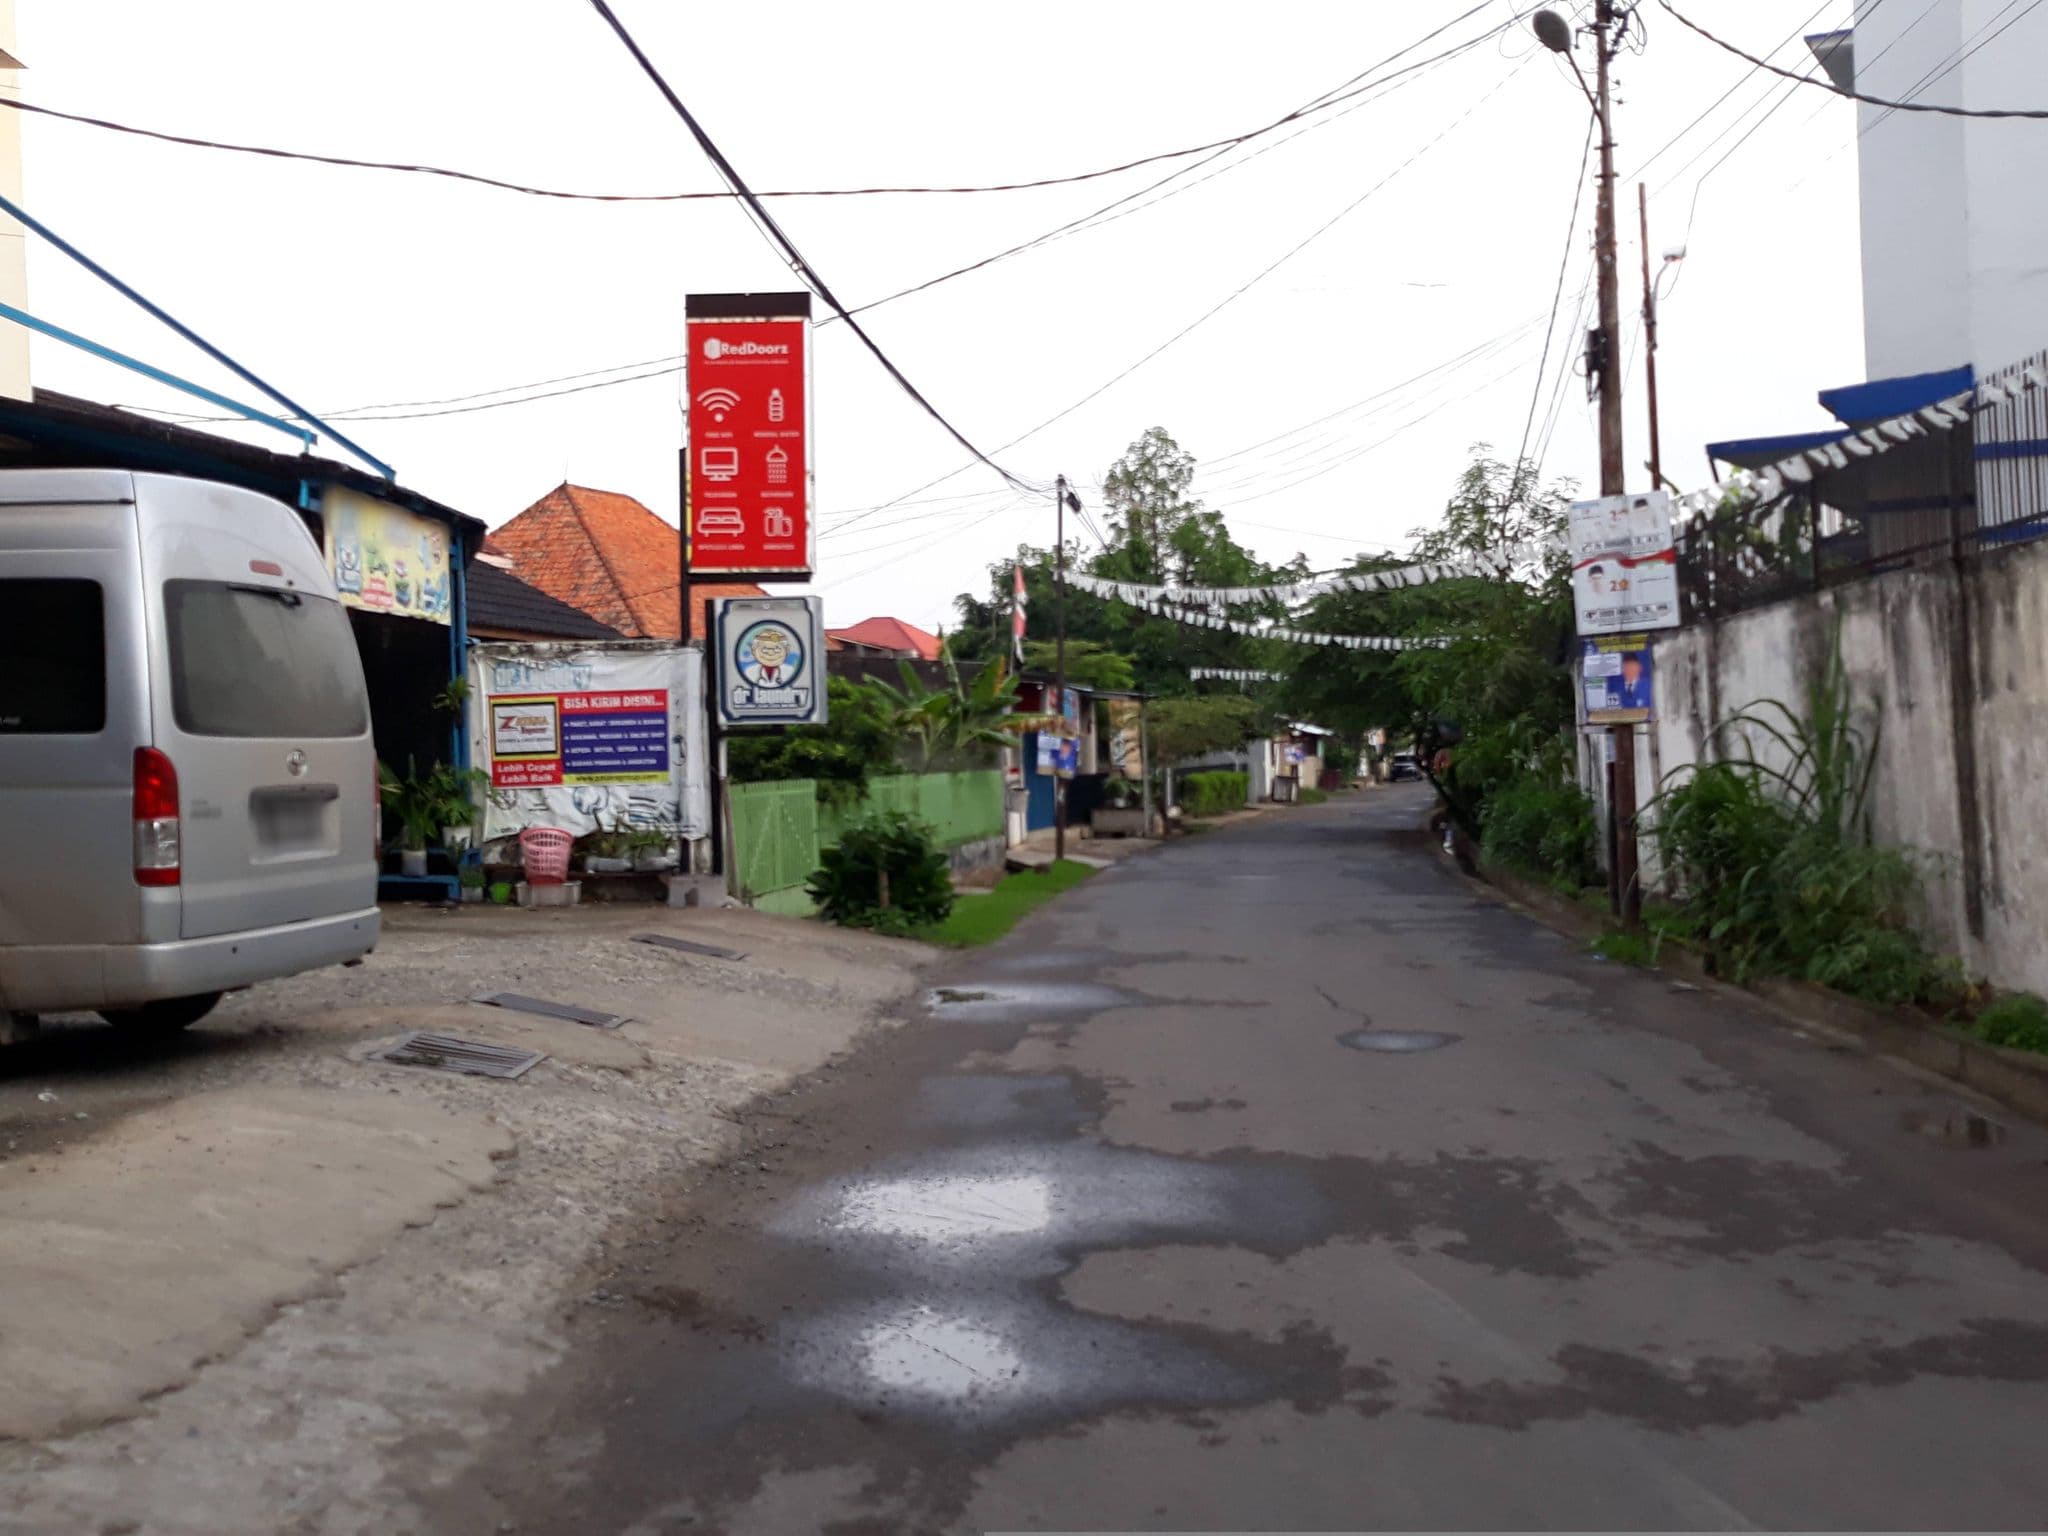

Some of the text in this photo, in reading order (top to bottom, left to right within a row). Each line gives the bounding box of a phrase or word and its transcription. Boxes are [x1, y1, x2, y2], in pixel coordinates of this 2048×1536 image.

[720, 342, 789, 355] RedDoorz
[563, 697, 589, 709] BISA
[591, 696, 621, 708] KIRIM
[498, 764, 524, 773] Lebih
[501, 774, 528, 783] Lebih
